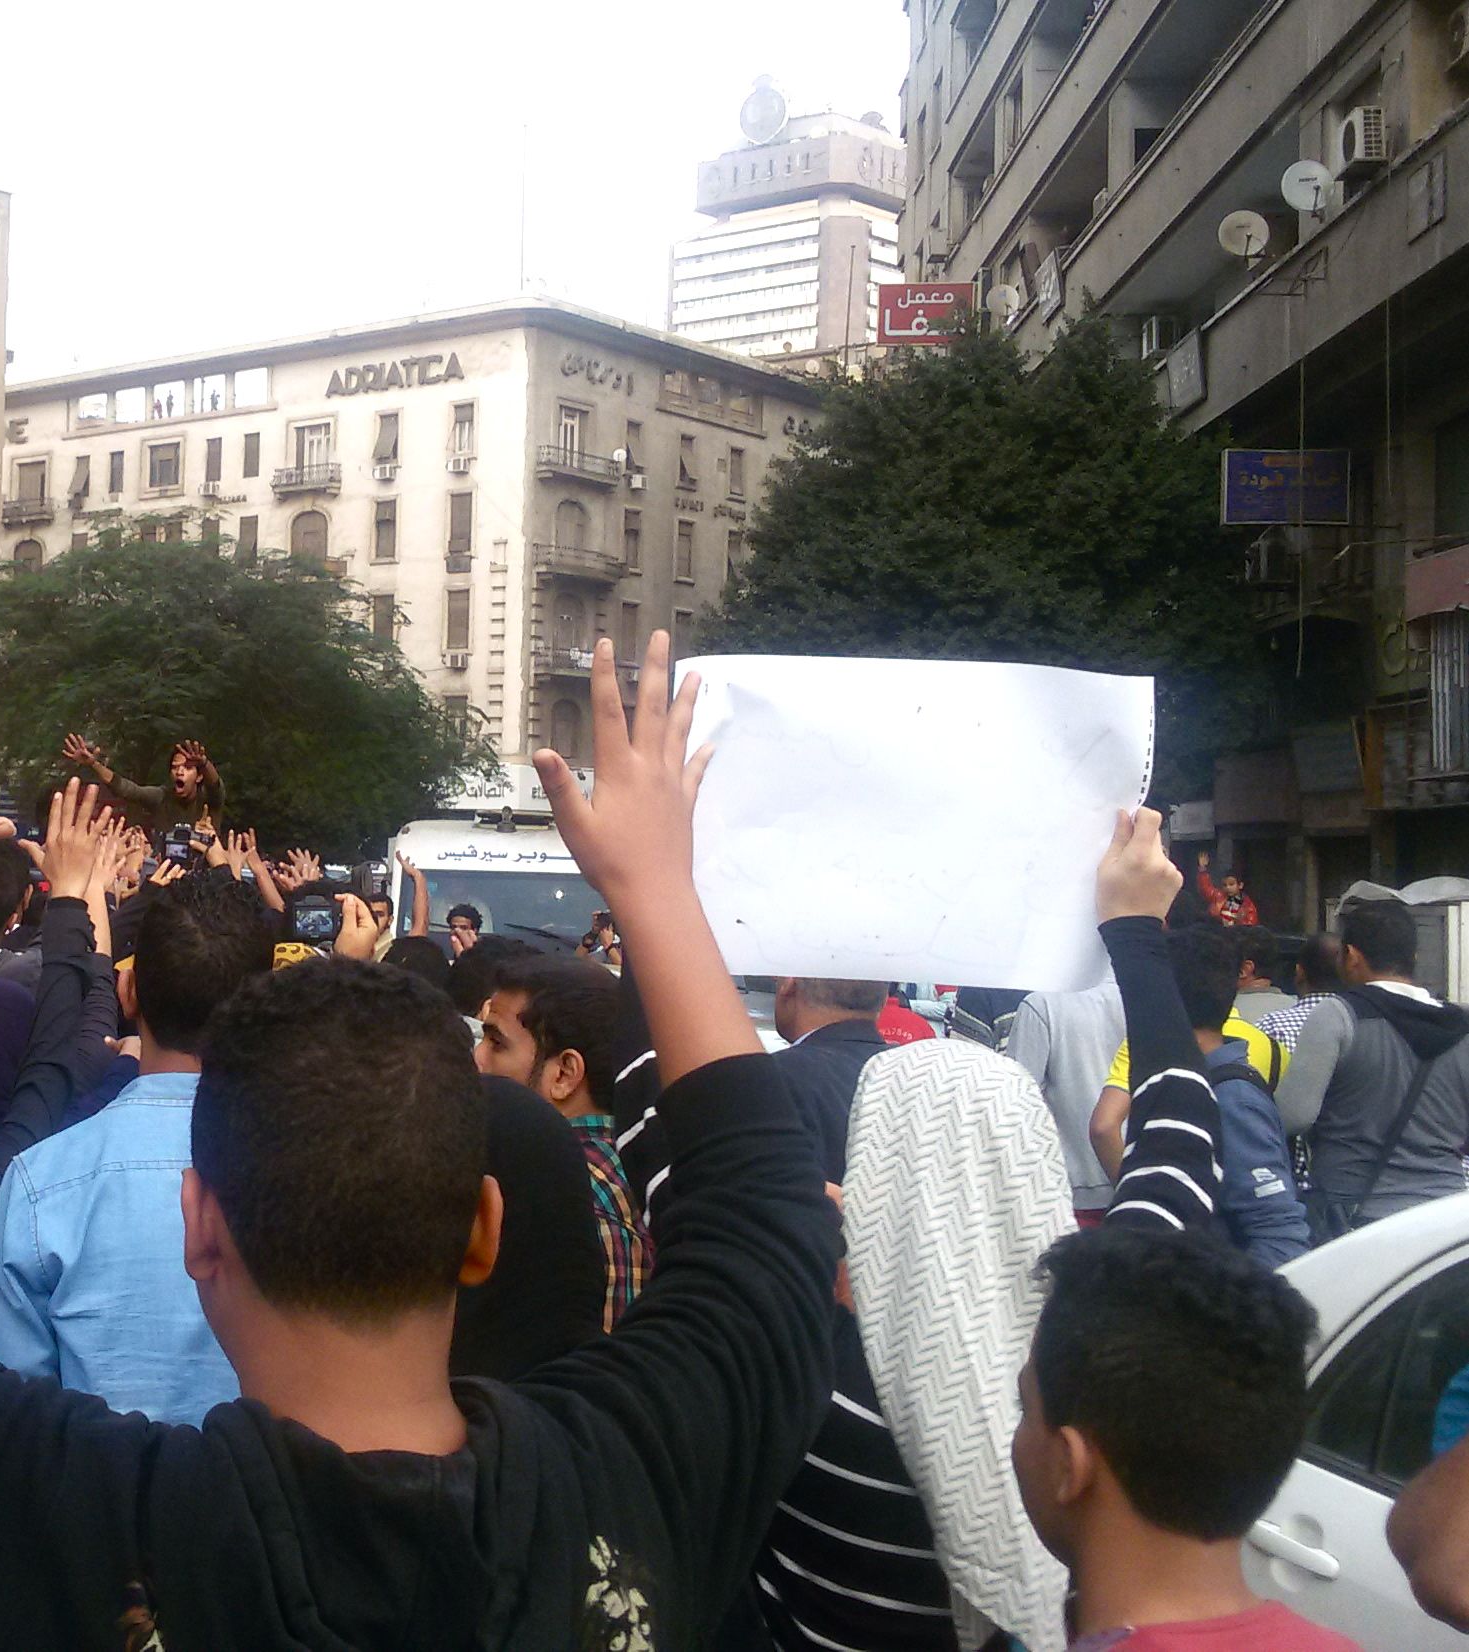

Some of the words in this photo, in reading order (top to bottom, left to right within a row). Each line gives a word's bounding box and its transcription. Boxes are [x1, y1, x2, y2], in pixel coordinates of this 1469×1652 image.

[897, 288, 955, 308] معمل
[325, 351, 465, 398] ADRIATICA
[512, 850, 575, 864] وبر
